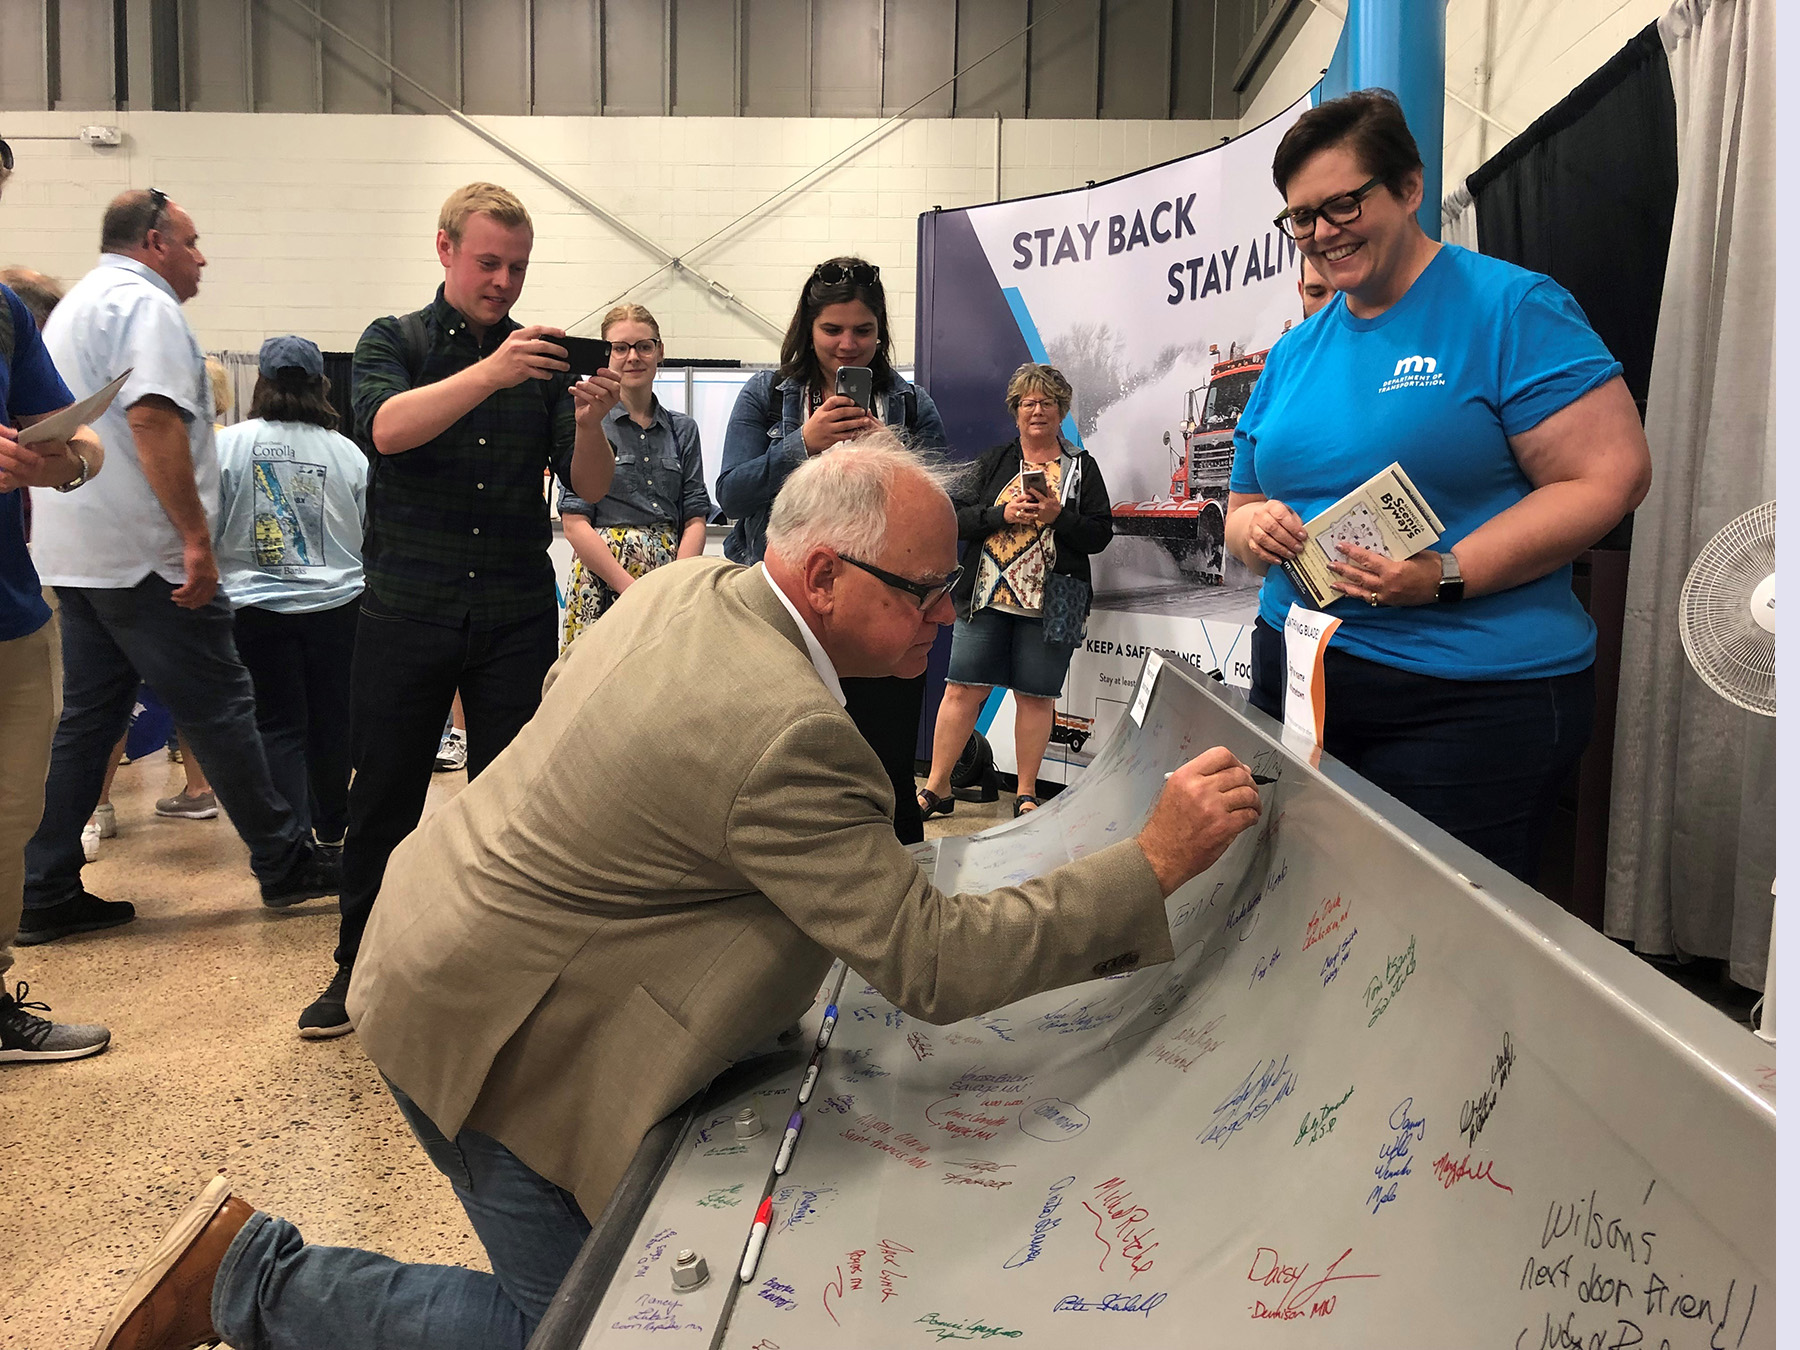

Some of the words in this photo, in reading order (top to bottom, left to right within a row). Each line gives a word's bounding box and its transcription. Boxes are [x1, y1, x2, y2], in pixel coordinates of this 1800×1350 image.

[1012, 221, 1100, 270] STAY
[1107, 193, 1198, 256] BACK
[1167, 245, 1239, 305] STAY
[1242, 232, 1298, 287] ALIV
[1378, 379, 1445, 393] TRANSPORTATION
[1383, 375, 1430, 387] DEPARTMENT
[253, 445, 295, 458] Corolla
[1380, 492, 1415, 539] Byways
[1393, 497, 1421, 535] Scenic
[1086, 639, 1114, 654] KEEP
[1117, 643, 1122, 655] A
[1099, 672, 1113, 685] Stay
[1114, 678, 1120, 686] at
[1234, 662, 1250, 679] FOC
[1520, 1254, 1574, 1290] next
[1577, 1262, 1634, 1308] door
[1309, 1295, 1337, 1320] MN
